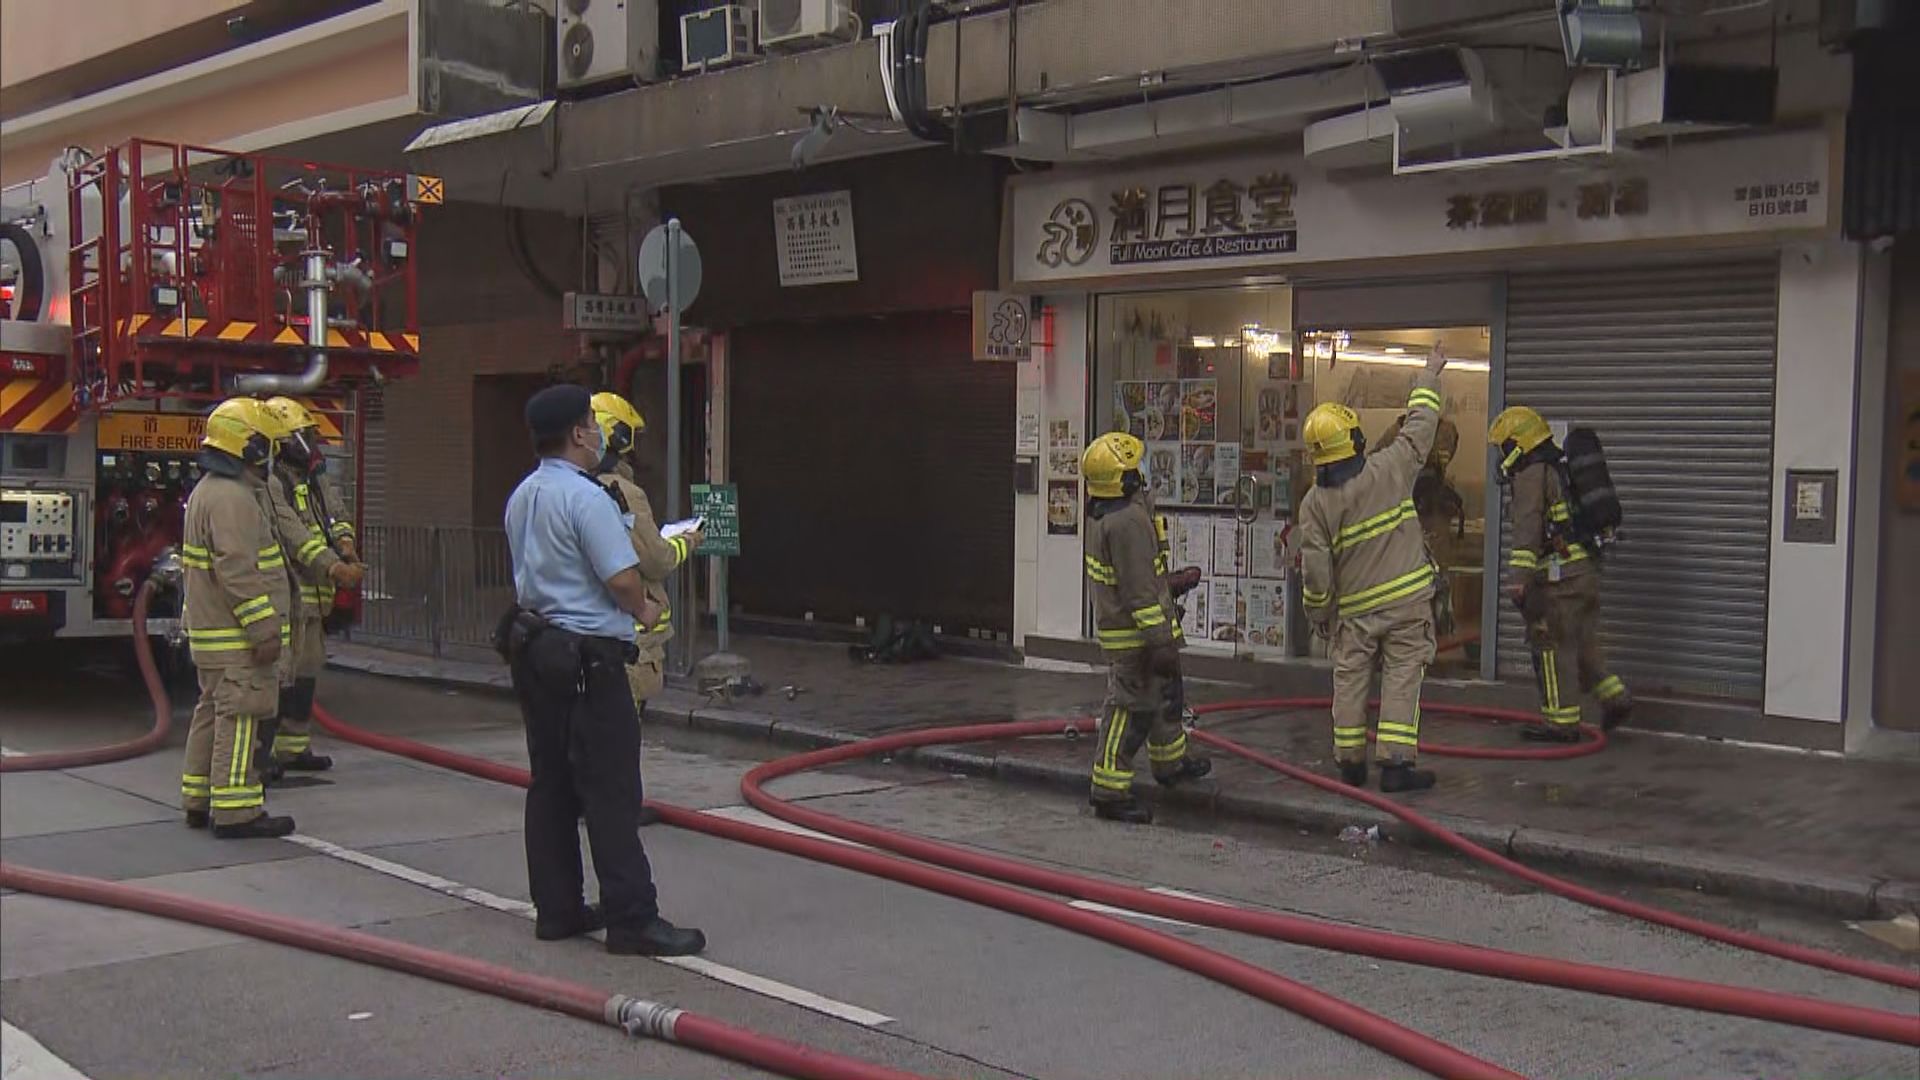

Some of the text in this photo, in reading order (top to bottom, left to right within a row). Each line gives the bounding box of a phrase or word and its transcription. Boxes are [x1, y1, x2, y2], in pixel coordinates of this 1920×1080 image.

[1109, 173, 1297, 241] 滿月食堂
[1111, 234, 1288, 261] Full Moon Cafe & Restaurant
[121, 435, 153, 448] FIRE
